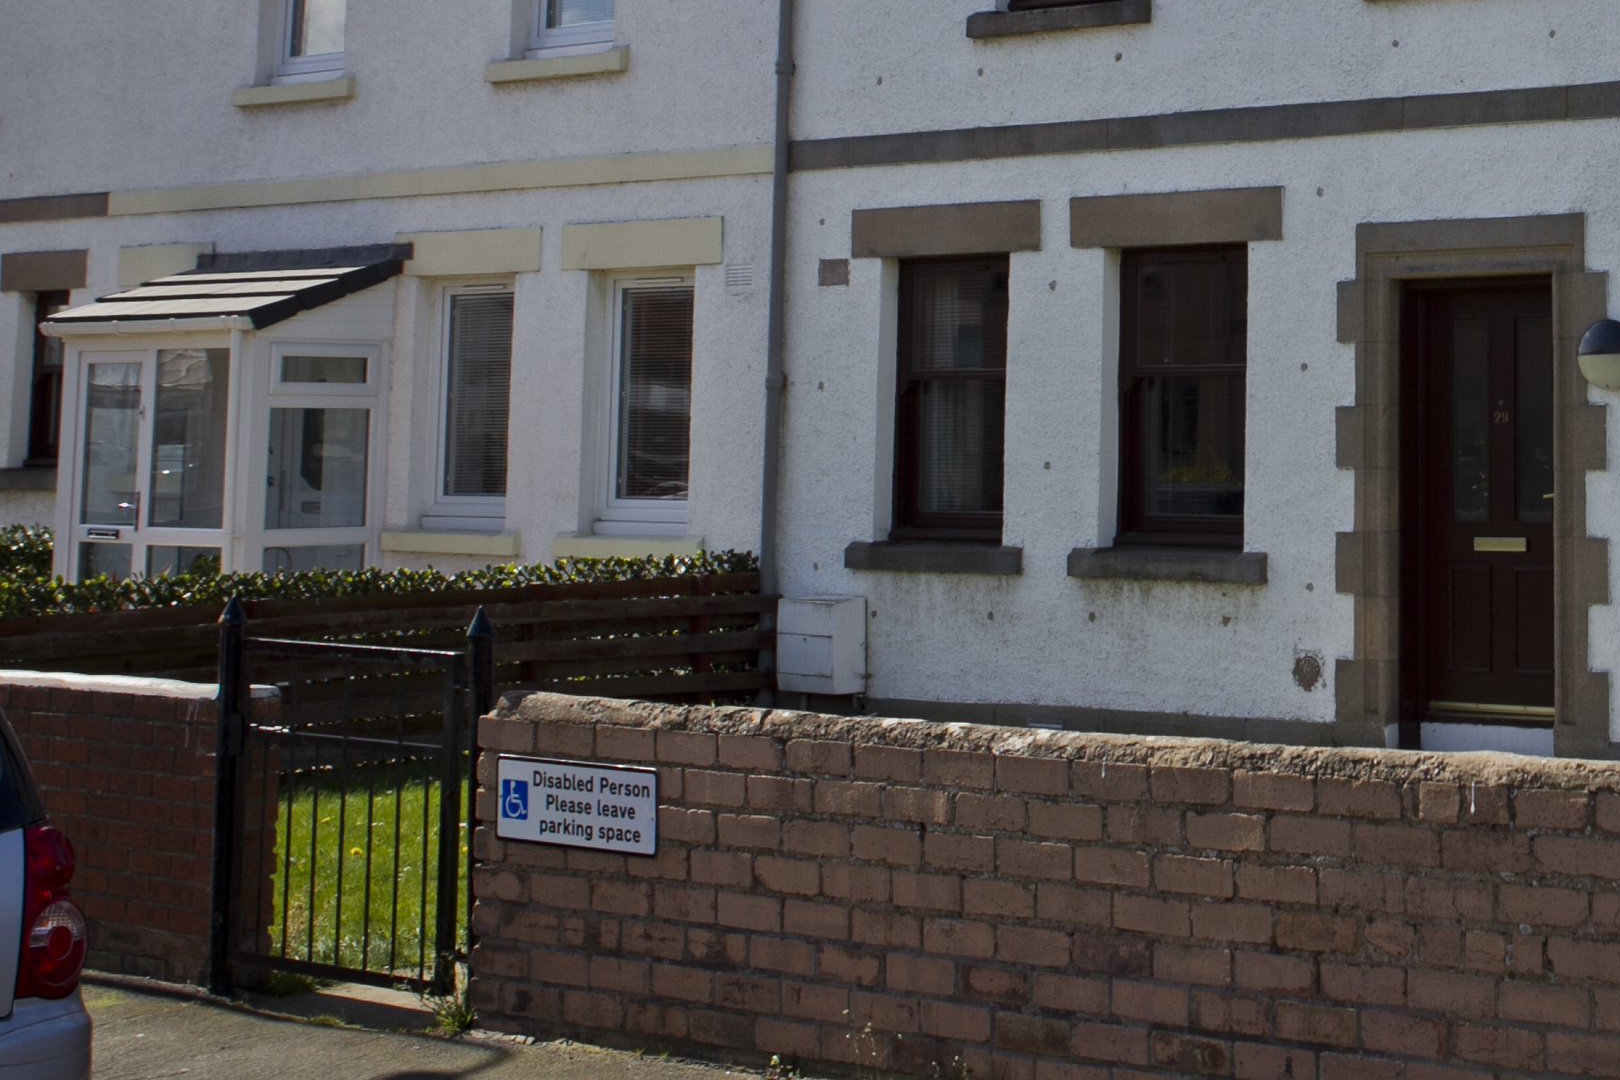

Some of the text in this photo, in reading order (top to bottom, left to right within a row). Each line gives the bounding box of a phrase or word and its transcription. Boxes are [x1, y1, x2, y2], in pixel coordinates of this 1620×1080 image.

[533, 770, 650, 798] Disabled Person
[546, 794, 636, 820] Please leave
[539, 818, 641, 843] parking space
